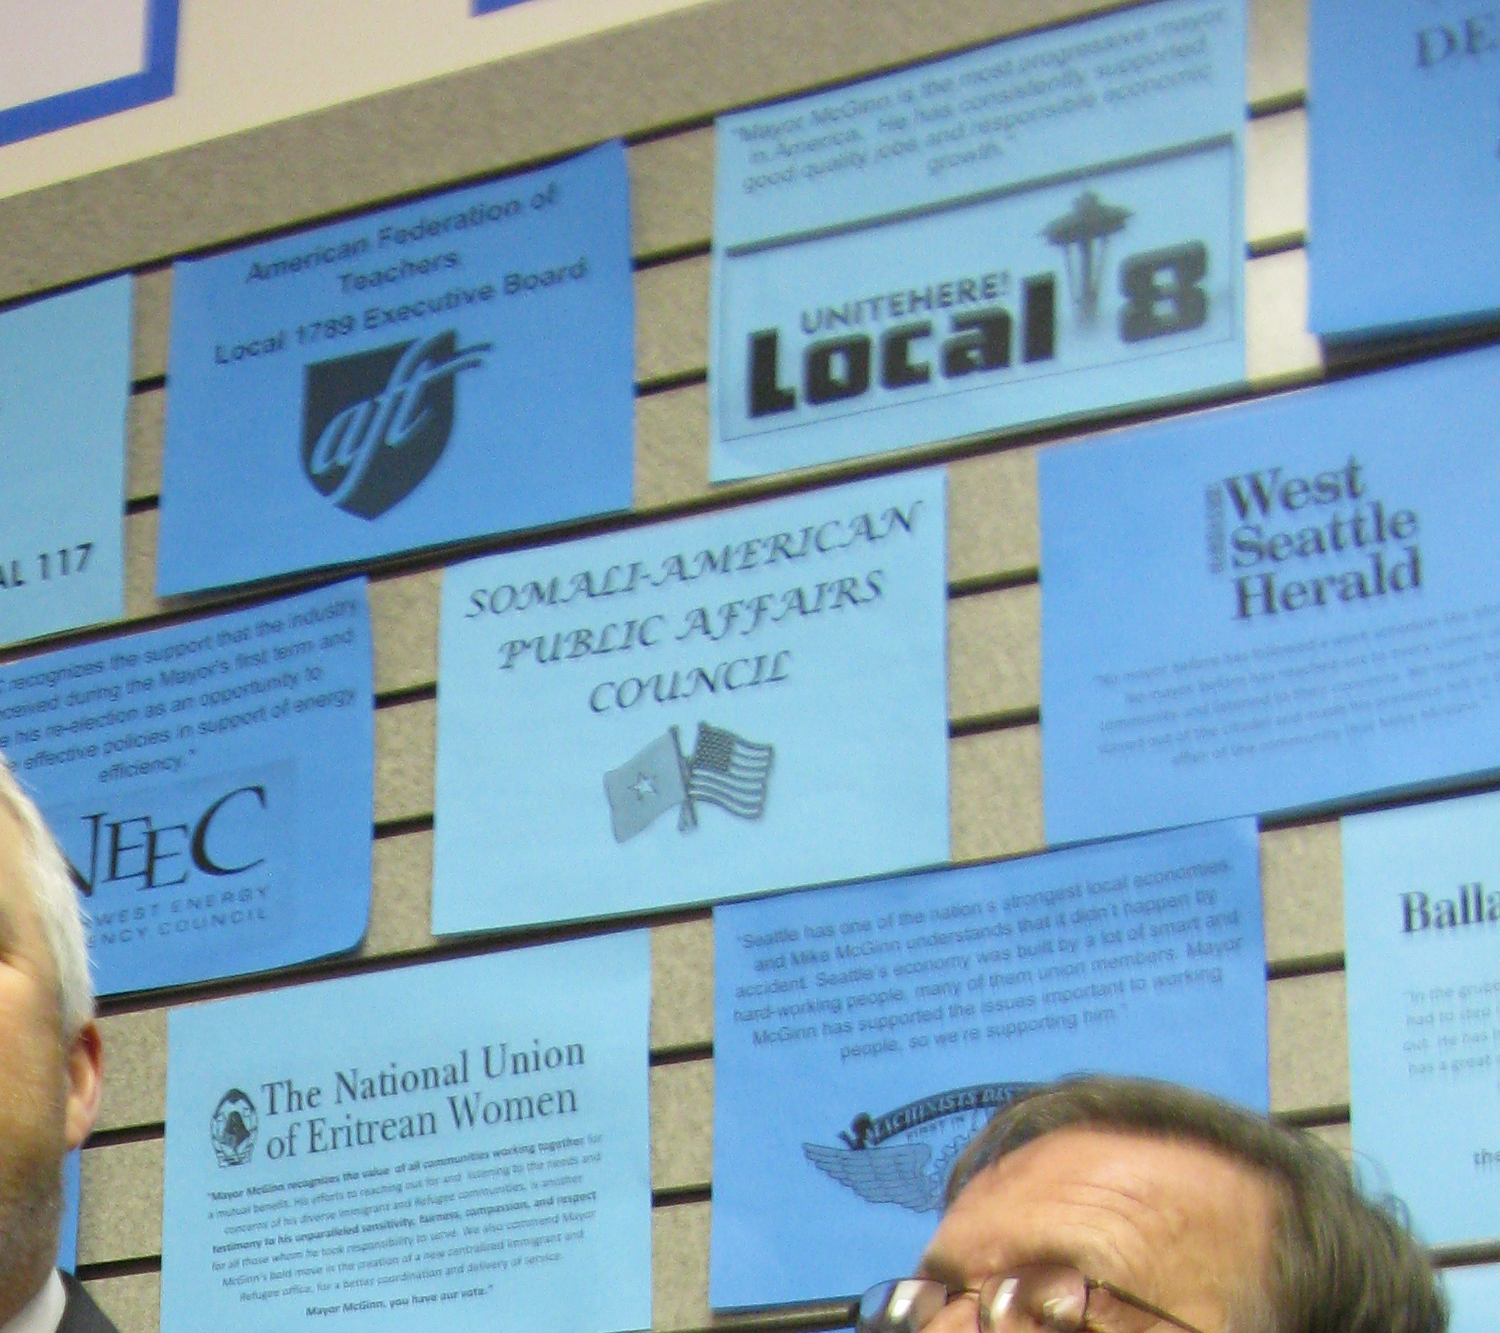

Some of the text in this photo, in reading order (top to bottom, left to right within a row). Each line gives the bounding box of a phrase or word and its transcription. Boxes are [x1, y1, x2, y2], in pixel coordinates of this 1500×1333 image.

[246, 182, 560, 283] American Federation of
[338, 248, 461, 293] Teachers
[800, 270, 1012, 334] UNITEHERE!
[213, 255, 589, 366] Local 1789 Executive Board
[746, 239, 1211, 420] Local 8
[1223, 452, 1366, 521] West
[36, 541, 95, 584] 117
[464, 499, 925, 619] SOMALI-AMERICAN
[1231, 501, 1420, 569] Seattle
[1231, 545, 1423, 621] Herald
[110, 652, 139, 671] the
[143, 636, 212, 664] support
[254, 617, 284, 637] the
[499, 568, 889, 671] PUBLIC AFFAIRS
[125, 676, 154, 695] the
[589, 648, 794, 715] COUNCIL
[158, 908, 268, 936] COUNCIL
[170, 885, 270, 914] ENERGY
[261, 1037, 586, 1118] The National Union
[266, 1086, 579, 1161] of Eritrean Women
